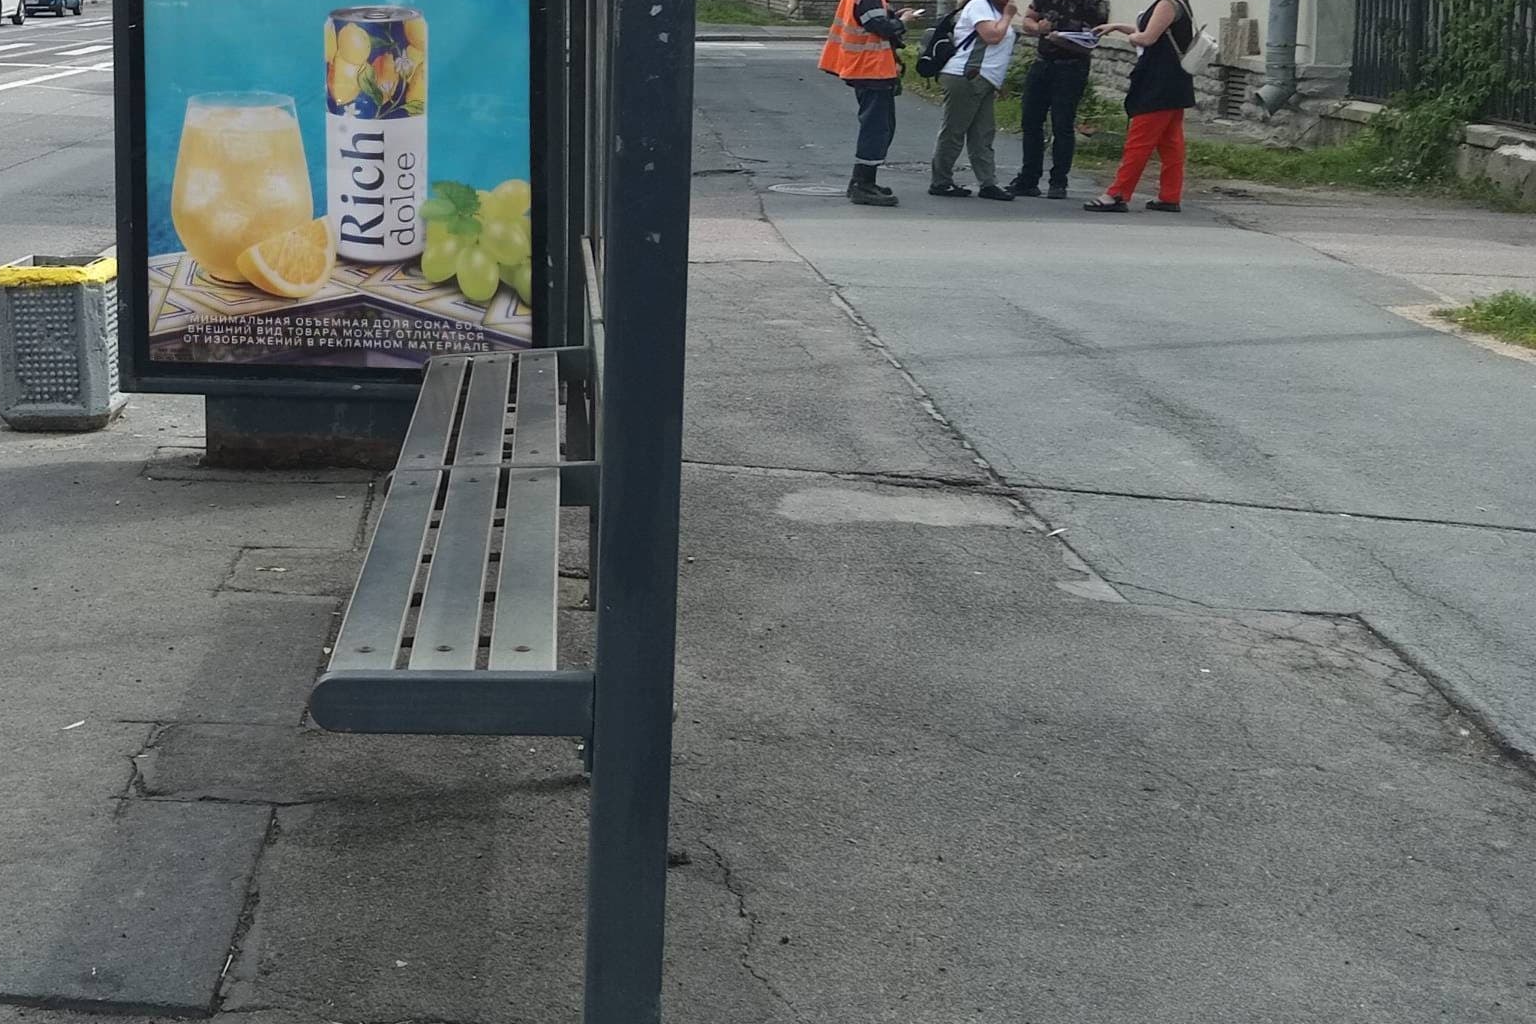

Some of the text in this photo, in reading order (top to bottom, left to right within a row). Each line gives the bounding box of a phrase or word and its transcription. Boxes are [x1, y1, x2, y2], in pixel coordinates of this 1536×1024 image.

[340, 131, 384, 248] Rich
[390, 152, 416, 246] dolce
[188, 324, 485, 341] ВНЕШНИЙ ВИД ТОВАРА МОЖЕТ ОТЛИЧАТЬСЯ
[372, 319, 409, 329] ДОЛЯ
[414, 320, 450, 330] СОКА
[183, 334, 489, 351] ОТ ИЗОБРАЖЕНИЙ В РЕКЛАМНОМ МАТЕРИАЛЕ
